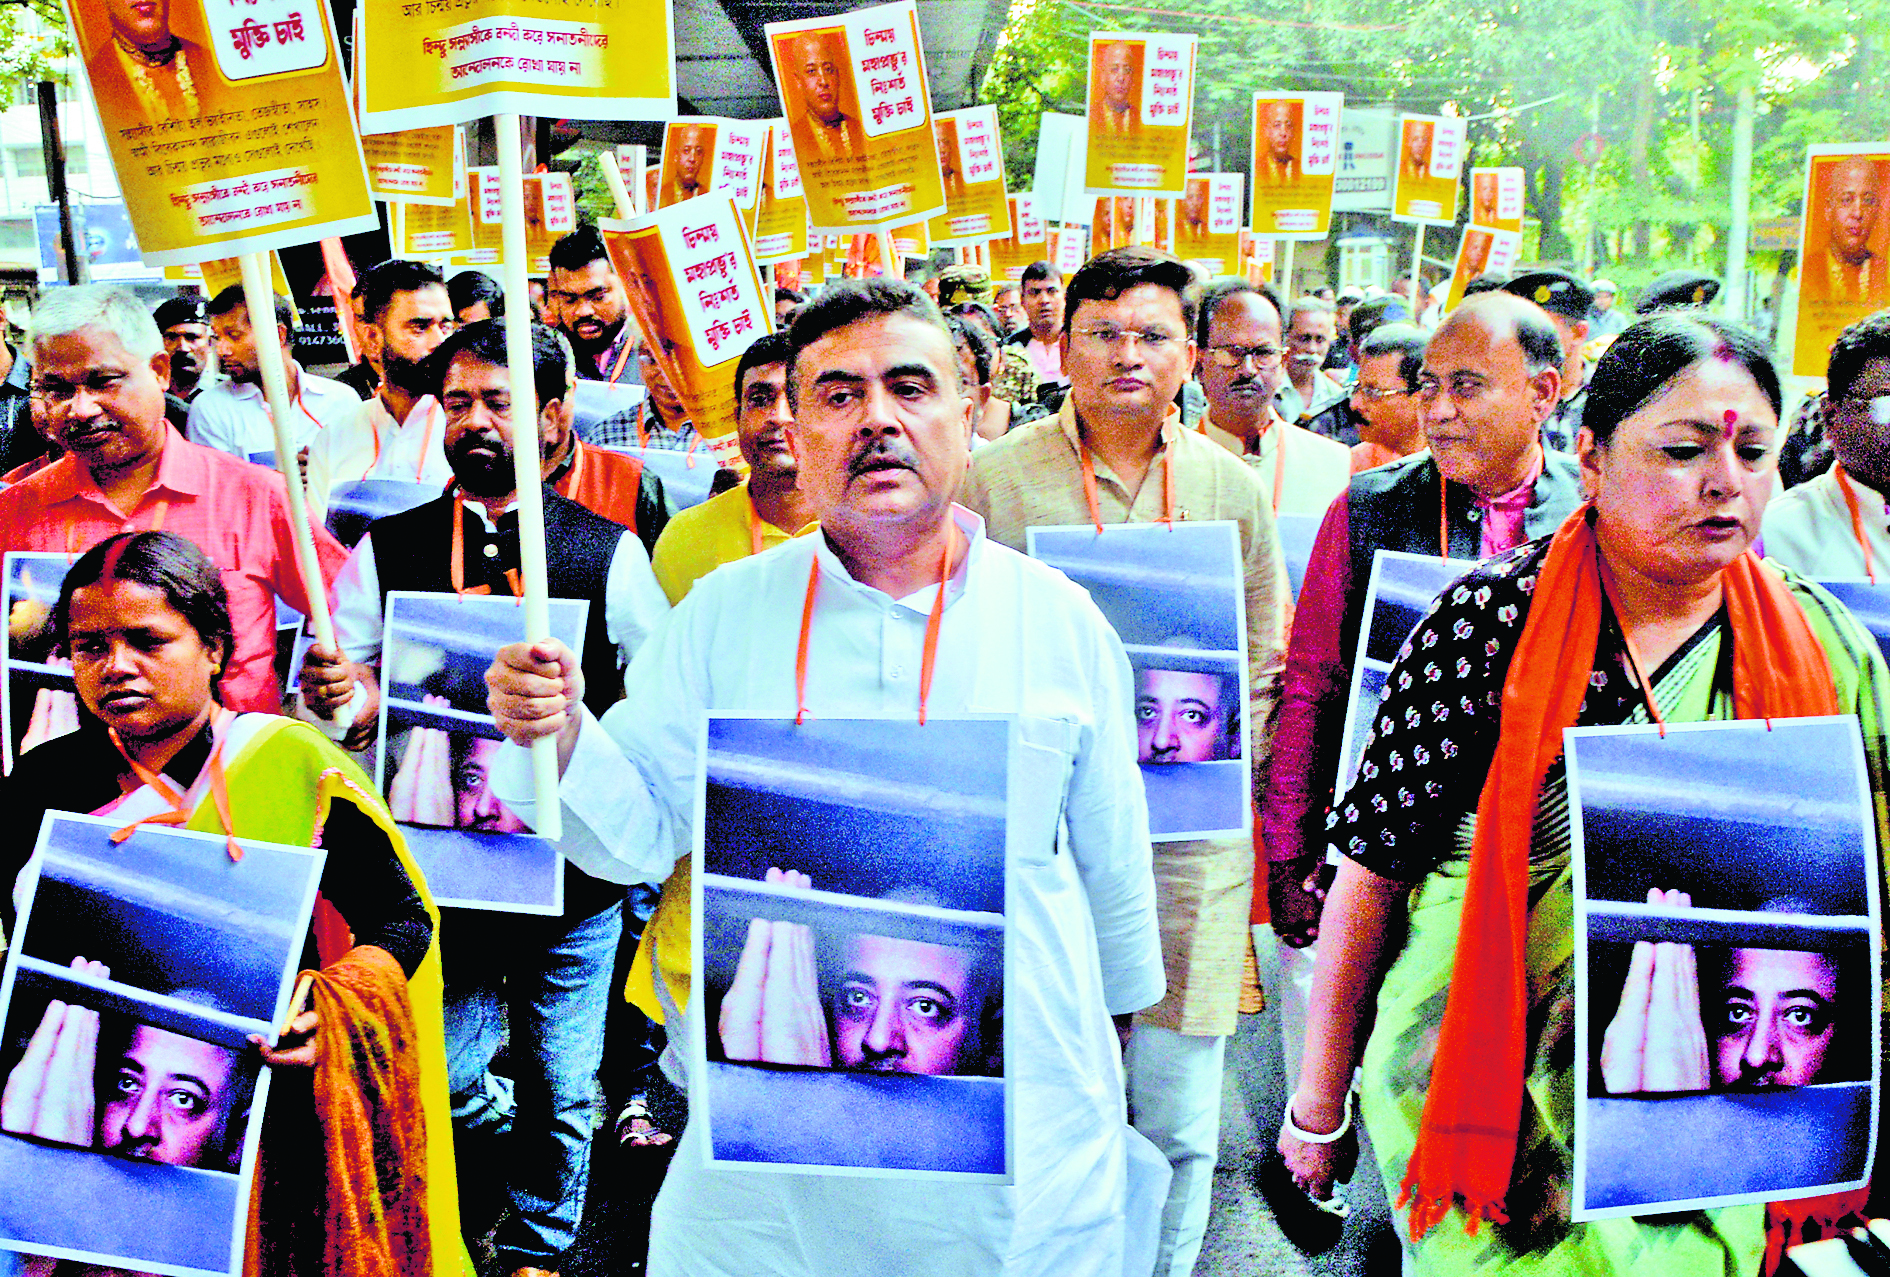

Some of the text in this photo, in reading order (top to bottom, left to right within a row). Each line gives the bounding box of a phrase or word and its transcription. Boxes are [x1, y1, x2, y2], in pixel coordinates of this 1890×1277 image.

[229, 11, 305, 60] মুক্তি চাই
[423, 37, 448, 58] হিন্দু
[496, 22, 520, 41] বন্দী
[523, 28, 543, 45] করে
[547, 27, 608, 50] সনাতনীদের
[863, 28, 896, 46] চিন্ময়
[517, 57, 544, 73] রোখা
[547, 60, 566, 75] যায়
[568, 60, 581, 75] না
[870, 71, 906, 95] নিঃশর্ত
[871, 96, 914, 125] মুক্তি চাই
[681, 223, 719, 249] চিন্ময়
[699, 278, 740, 312] নিঃশর্ত
[704, 309, 753, 351] মুক্তি চাই
